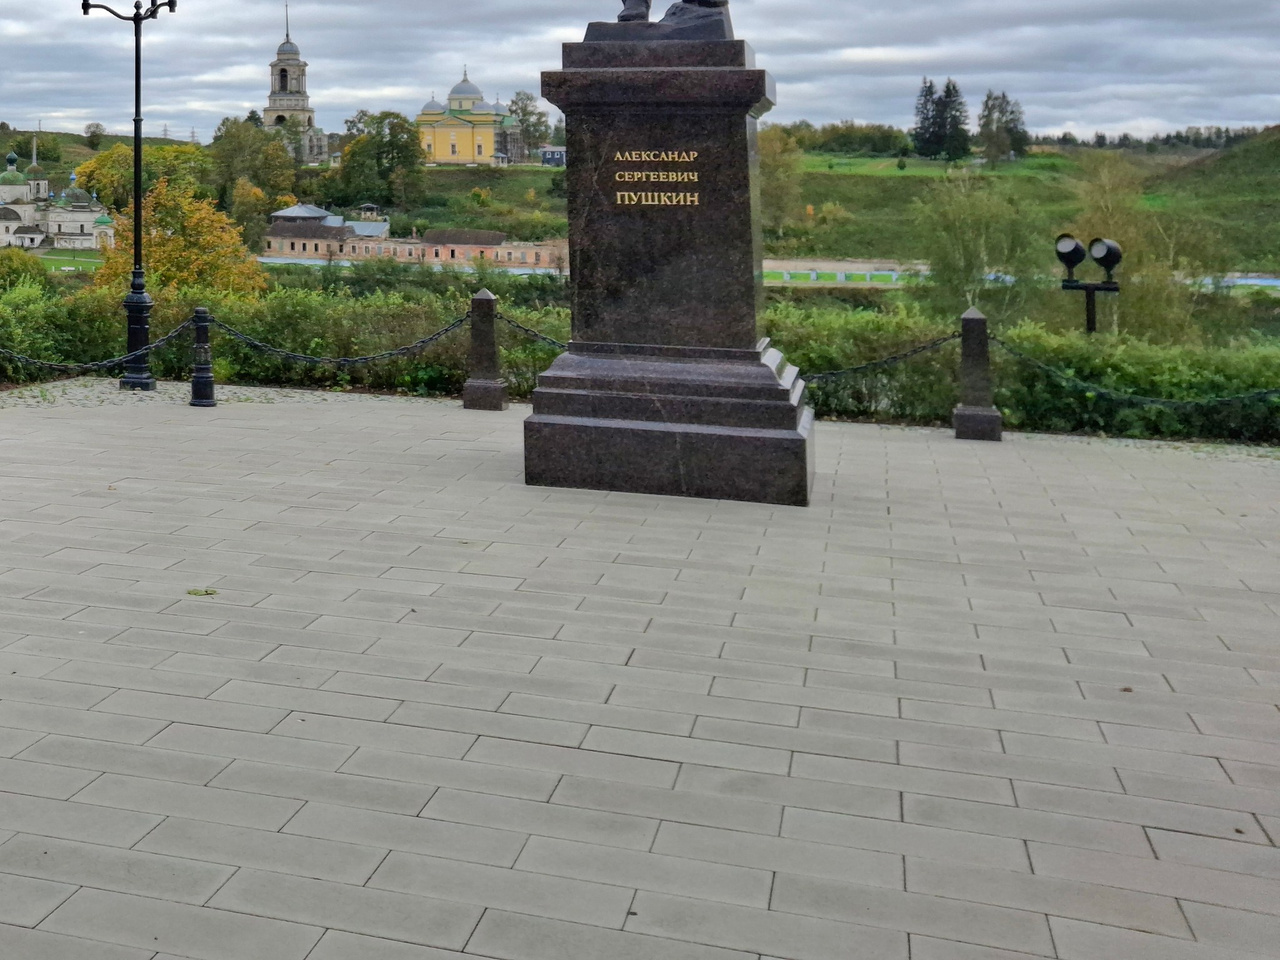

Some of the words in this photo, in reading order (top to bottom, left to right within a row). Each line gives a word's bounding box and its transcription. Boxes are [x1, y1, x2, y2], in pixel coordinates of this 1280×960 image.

[614, 151, 698, 162] АЛЕКСАНДР
[615, 171, 699, 182] СЕРГЕЕВИЧ
[616, 191, 700, 205] ПУШКИН
